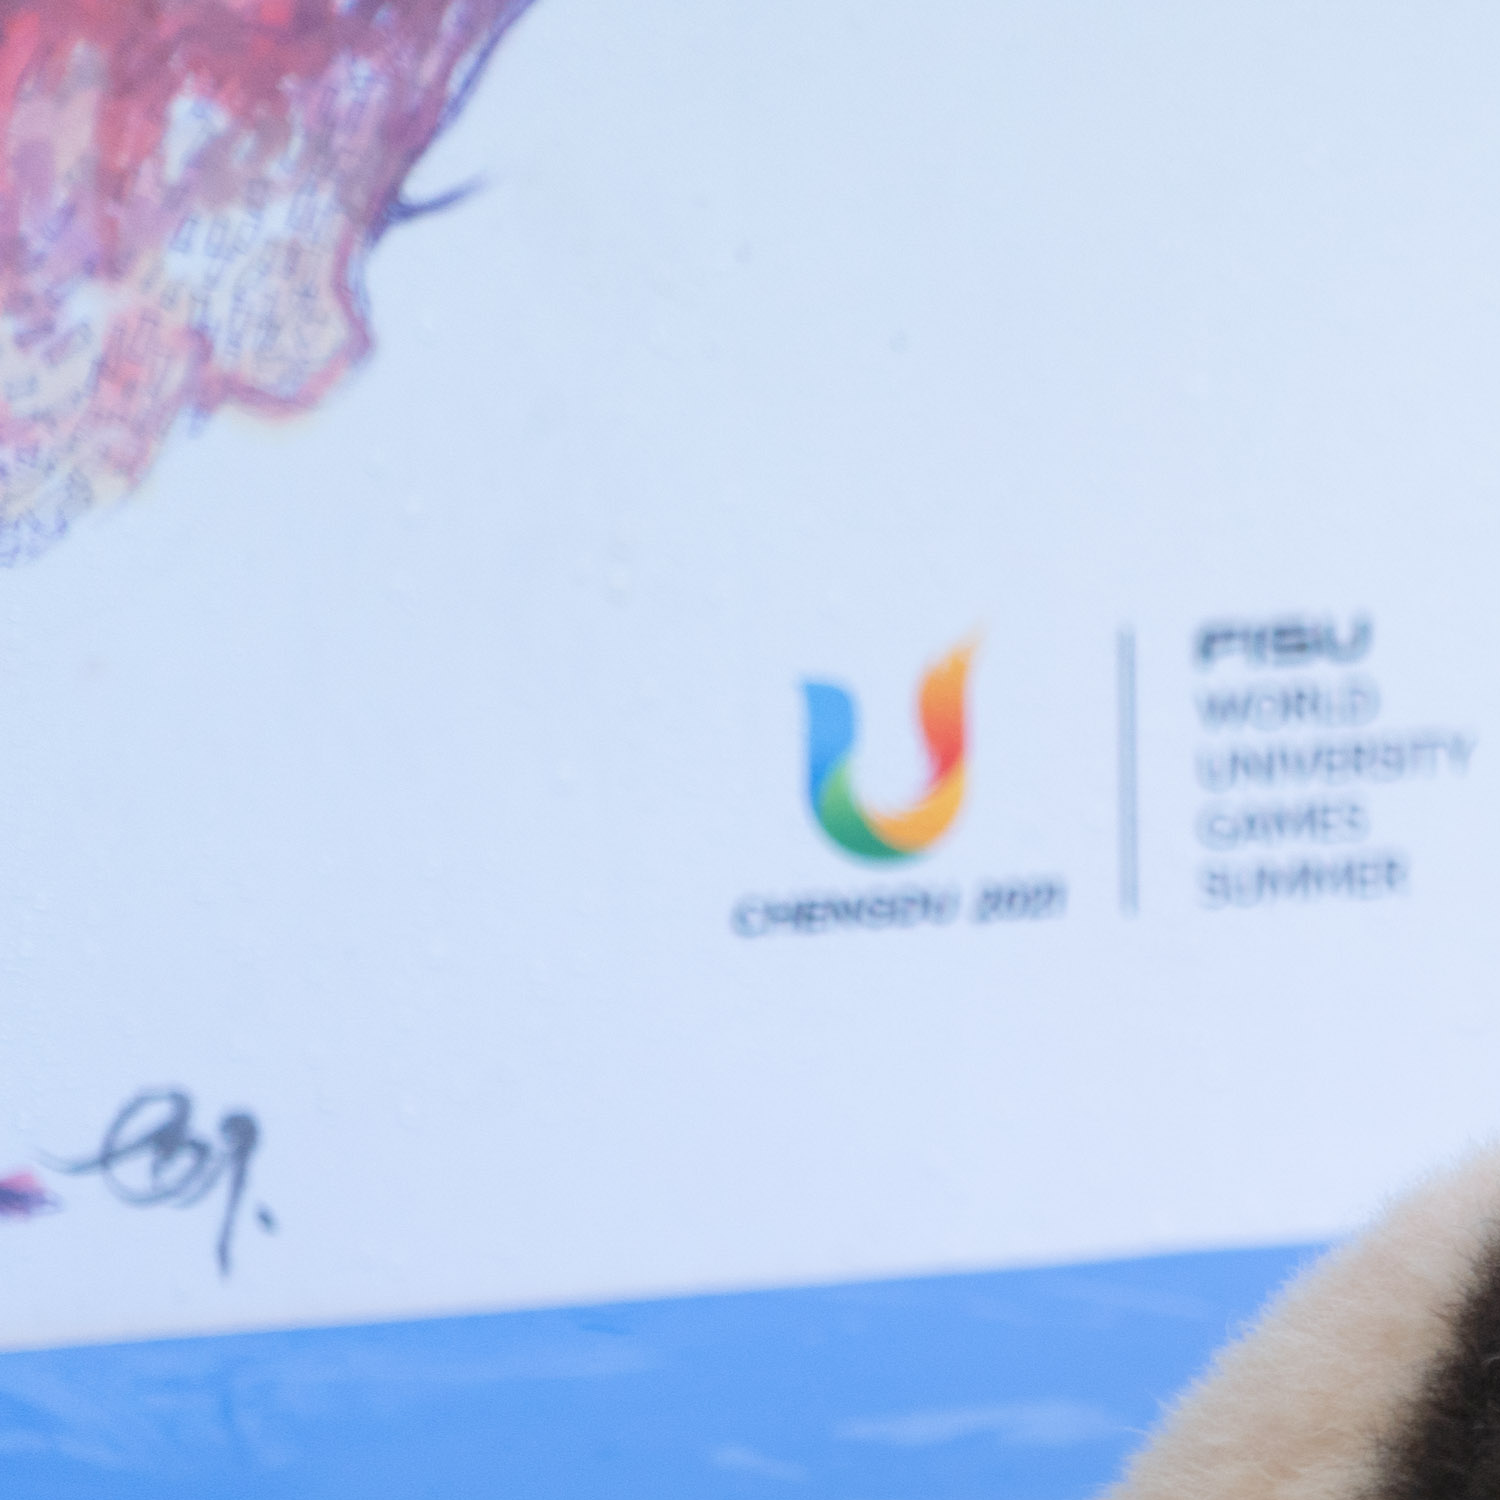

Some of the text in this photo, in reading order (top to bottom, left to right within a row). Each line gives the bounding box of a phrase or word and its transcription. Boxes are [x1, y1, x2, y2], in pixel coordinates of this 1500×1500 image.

[1193, 615, 1374, 668] FISU
[1195, 680, 1380, 730] WORLD
[1196, 733, 1478, 792] UNIVERSITY
[1197, 800, 1368, 850] GAMES
[1197, 857, 1408, 910] SUMMER
